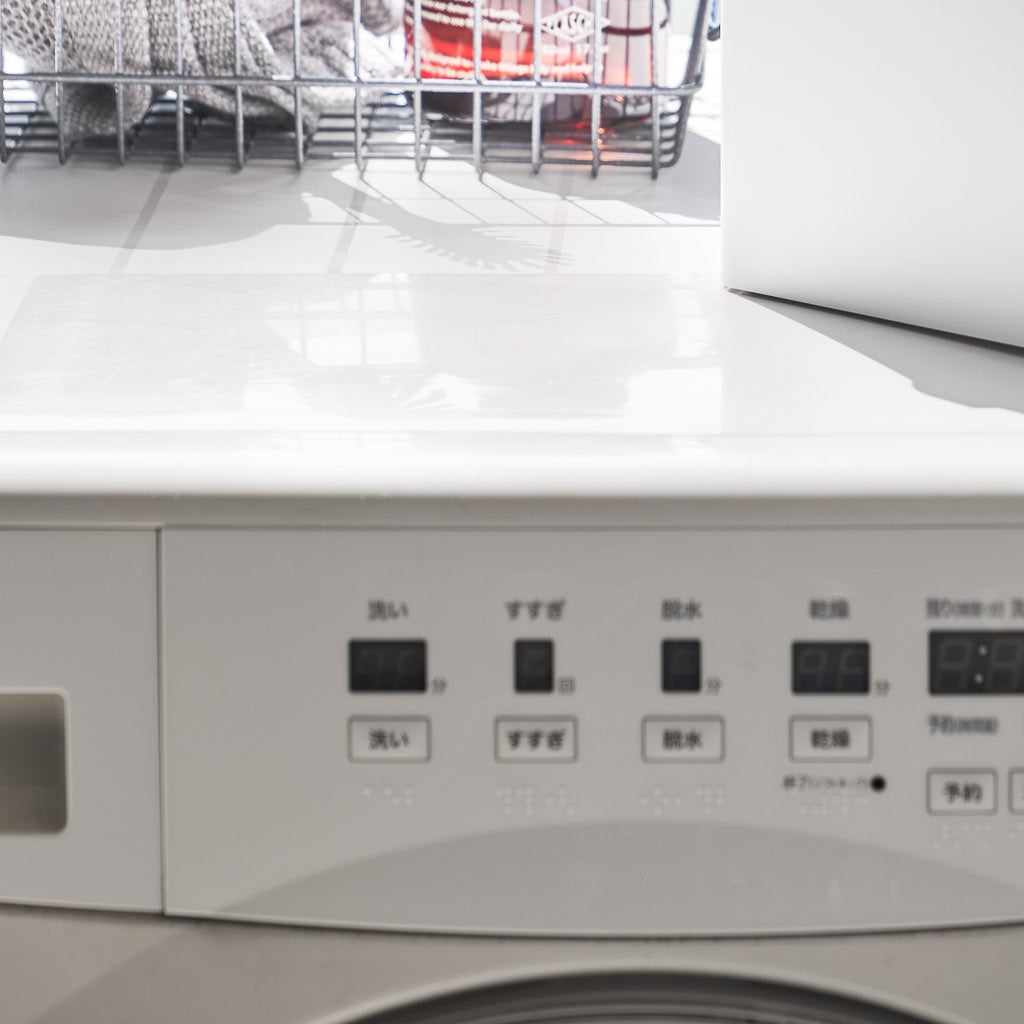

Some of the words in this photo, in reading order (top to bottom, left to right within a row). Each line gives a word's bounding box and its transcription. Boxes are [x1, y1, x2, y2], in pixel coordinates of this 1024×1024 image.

[368, 600, 409, 621] 洗い
[506, 599, 566, 621] すすぎ
[661, 599, 702, 621] 脱水
[809, 599, 850, 620] 乾燥
[369, 728, 409, 750] 洗い
[507, 728, 566, 750] すすぎ
[662, 728, 702, 750] 脱水
[810, 728, 851, 749] 乾燥
[944, 782, 983, 803] 予約
